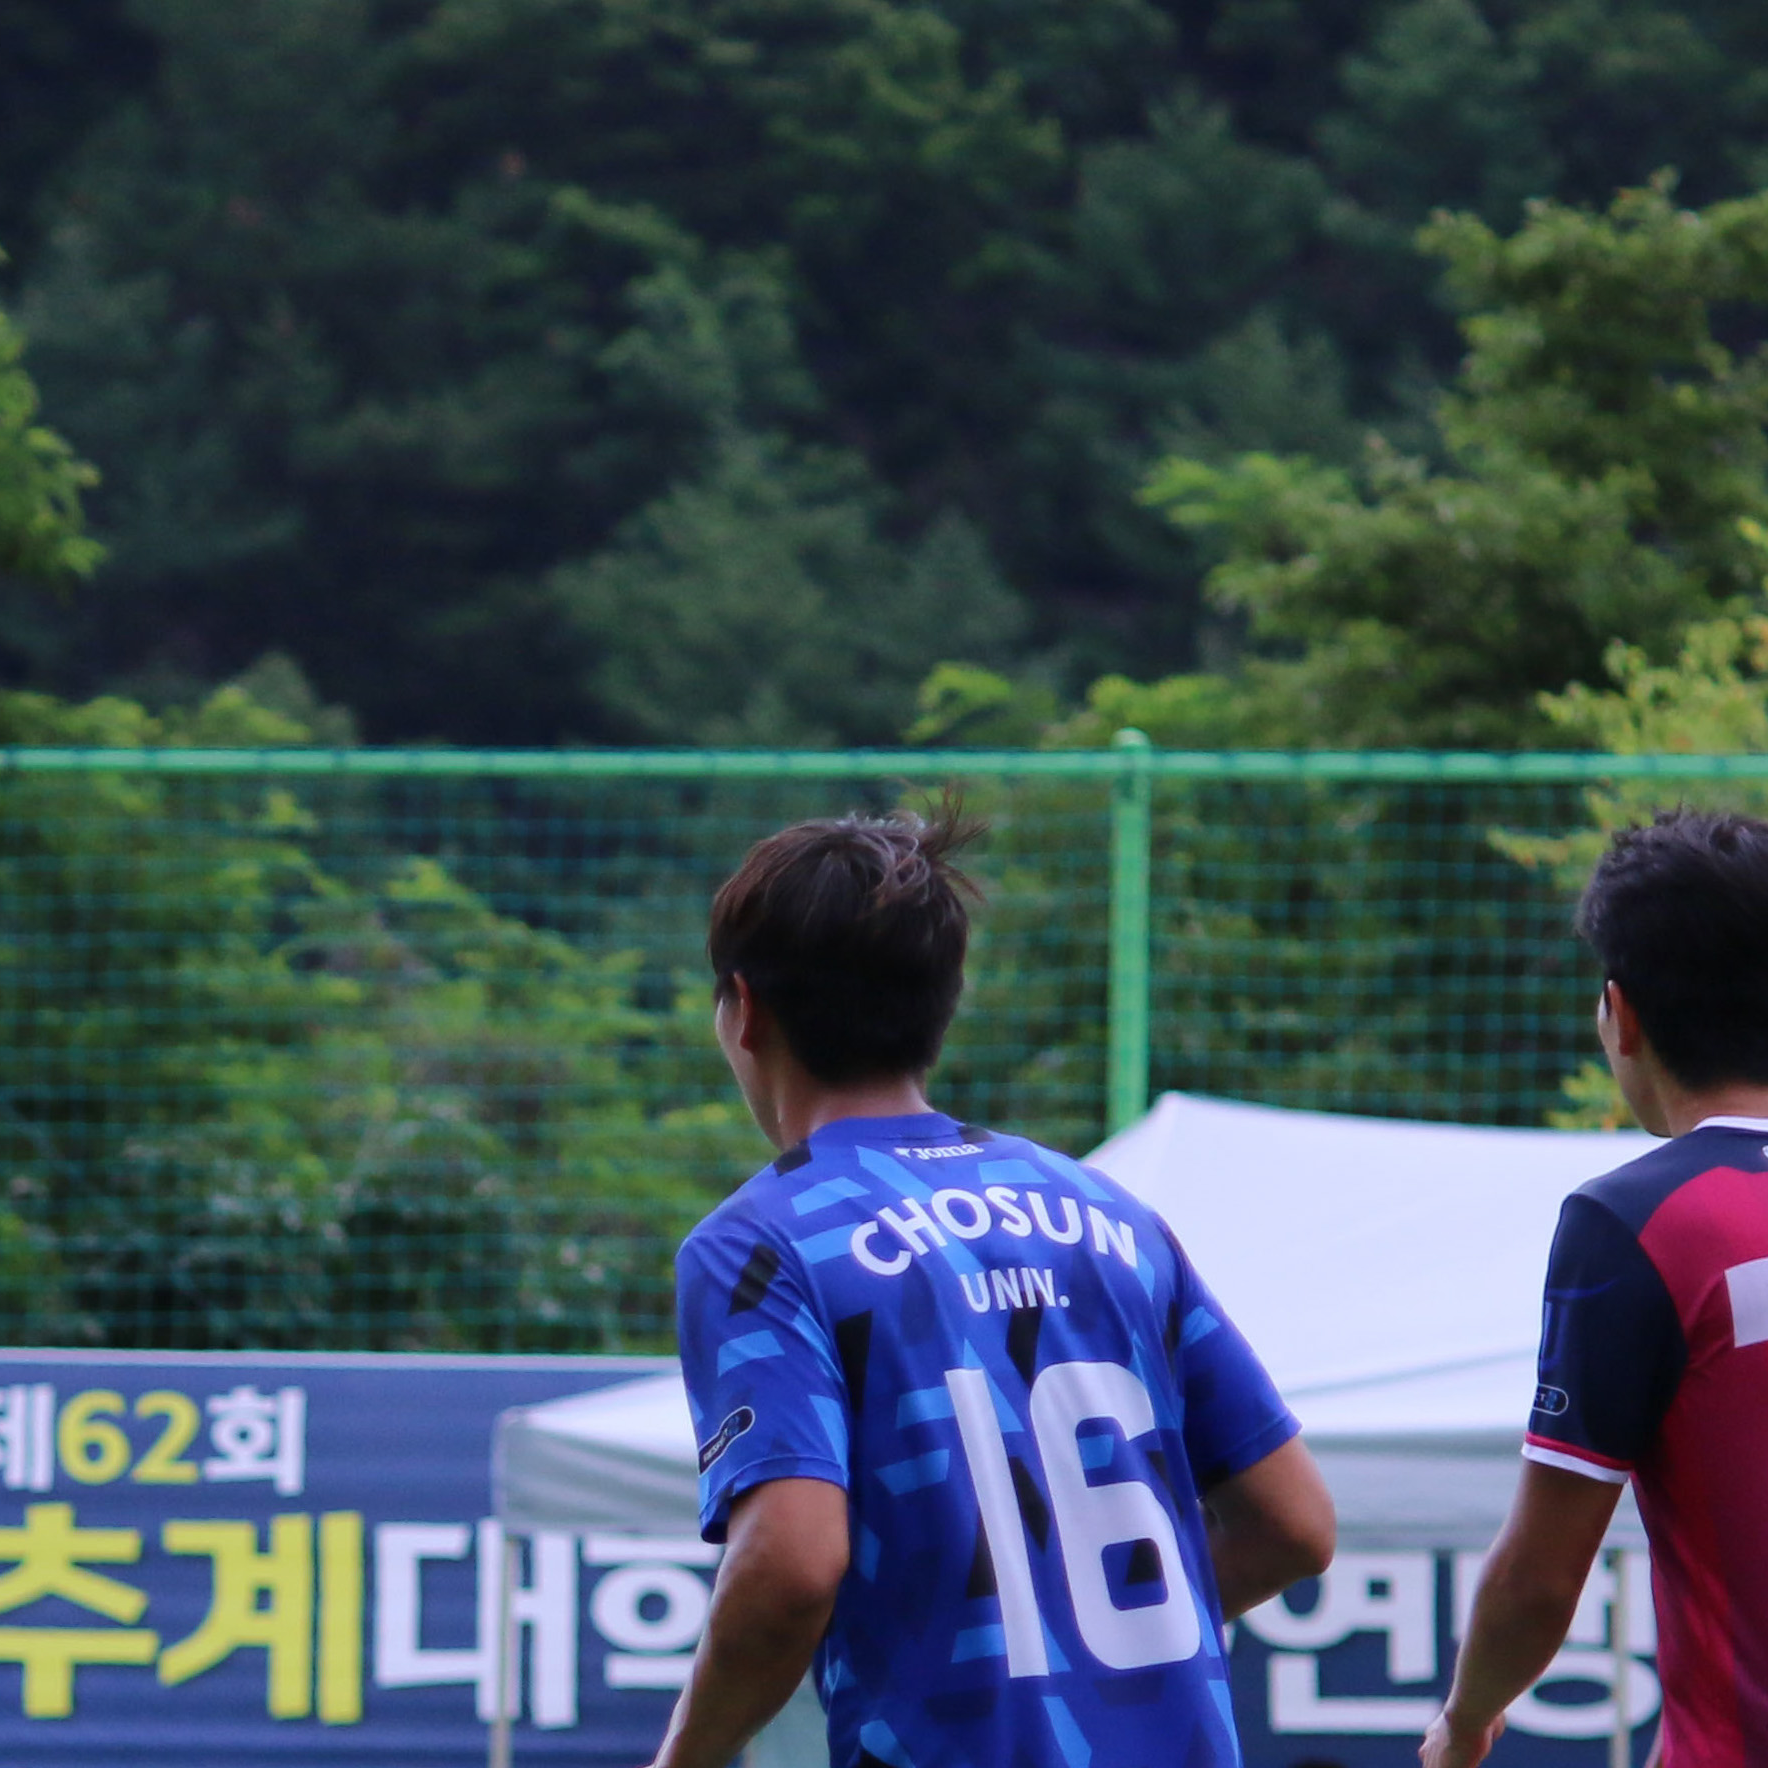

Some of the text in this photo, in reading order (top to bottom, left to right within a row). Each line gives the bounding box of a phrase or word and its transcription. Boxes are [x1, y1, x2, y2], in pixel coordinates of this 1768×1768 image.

[850, 1184, 1140, 1277] CHOSUN
[958, 1267, 1071, 1314] UNIV.
[944, 1360, 1202, 1678] 16
